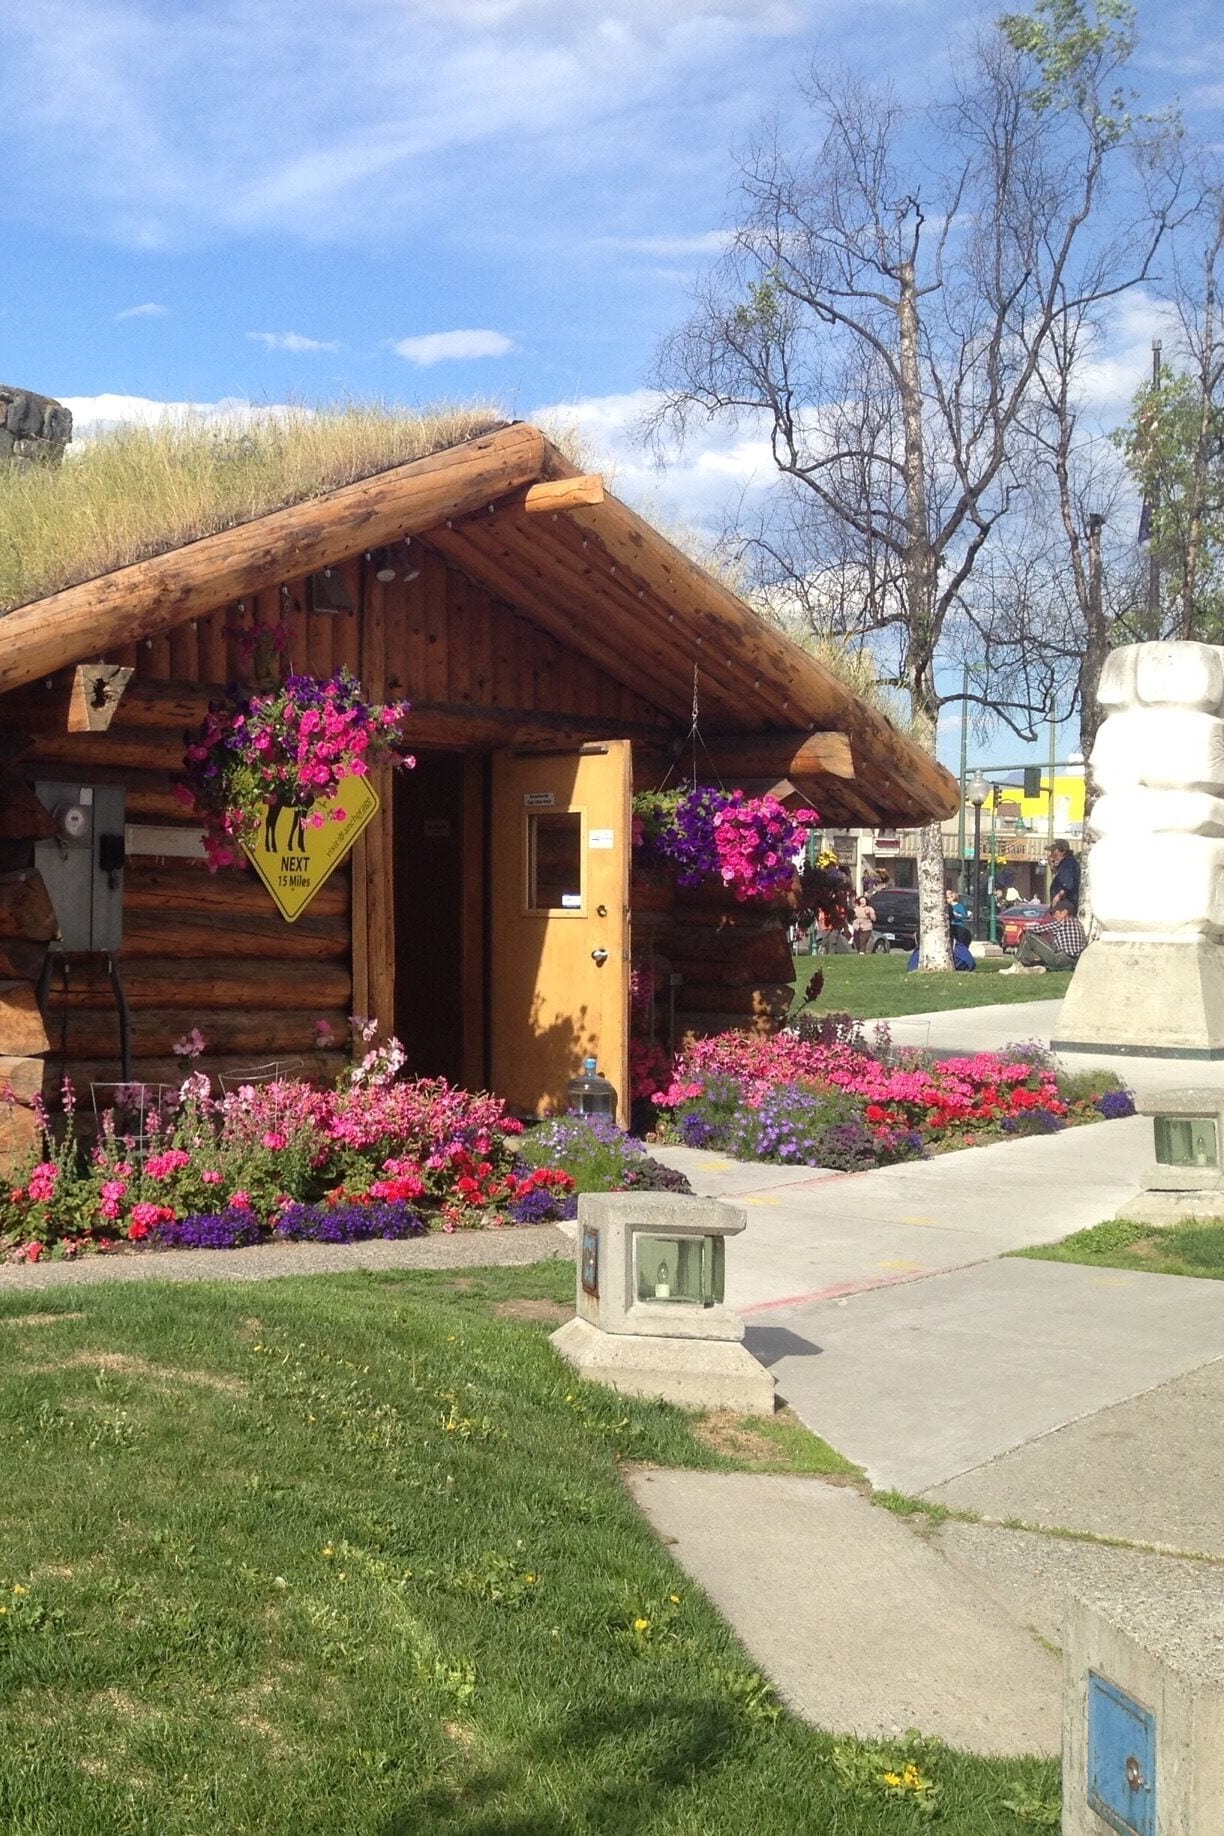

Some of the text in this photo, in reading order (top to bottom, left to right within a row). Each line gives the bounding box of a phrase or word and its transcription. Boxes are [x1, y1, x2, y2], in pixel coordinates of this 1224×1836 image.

[281, 856, 310, 872] NEXT
[278, 875, 311, 887] 15 Miles
